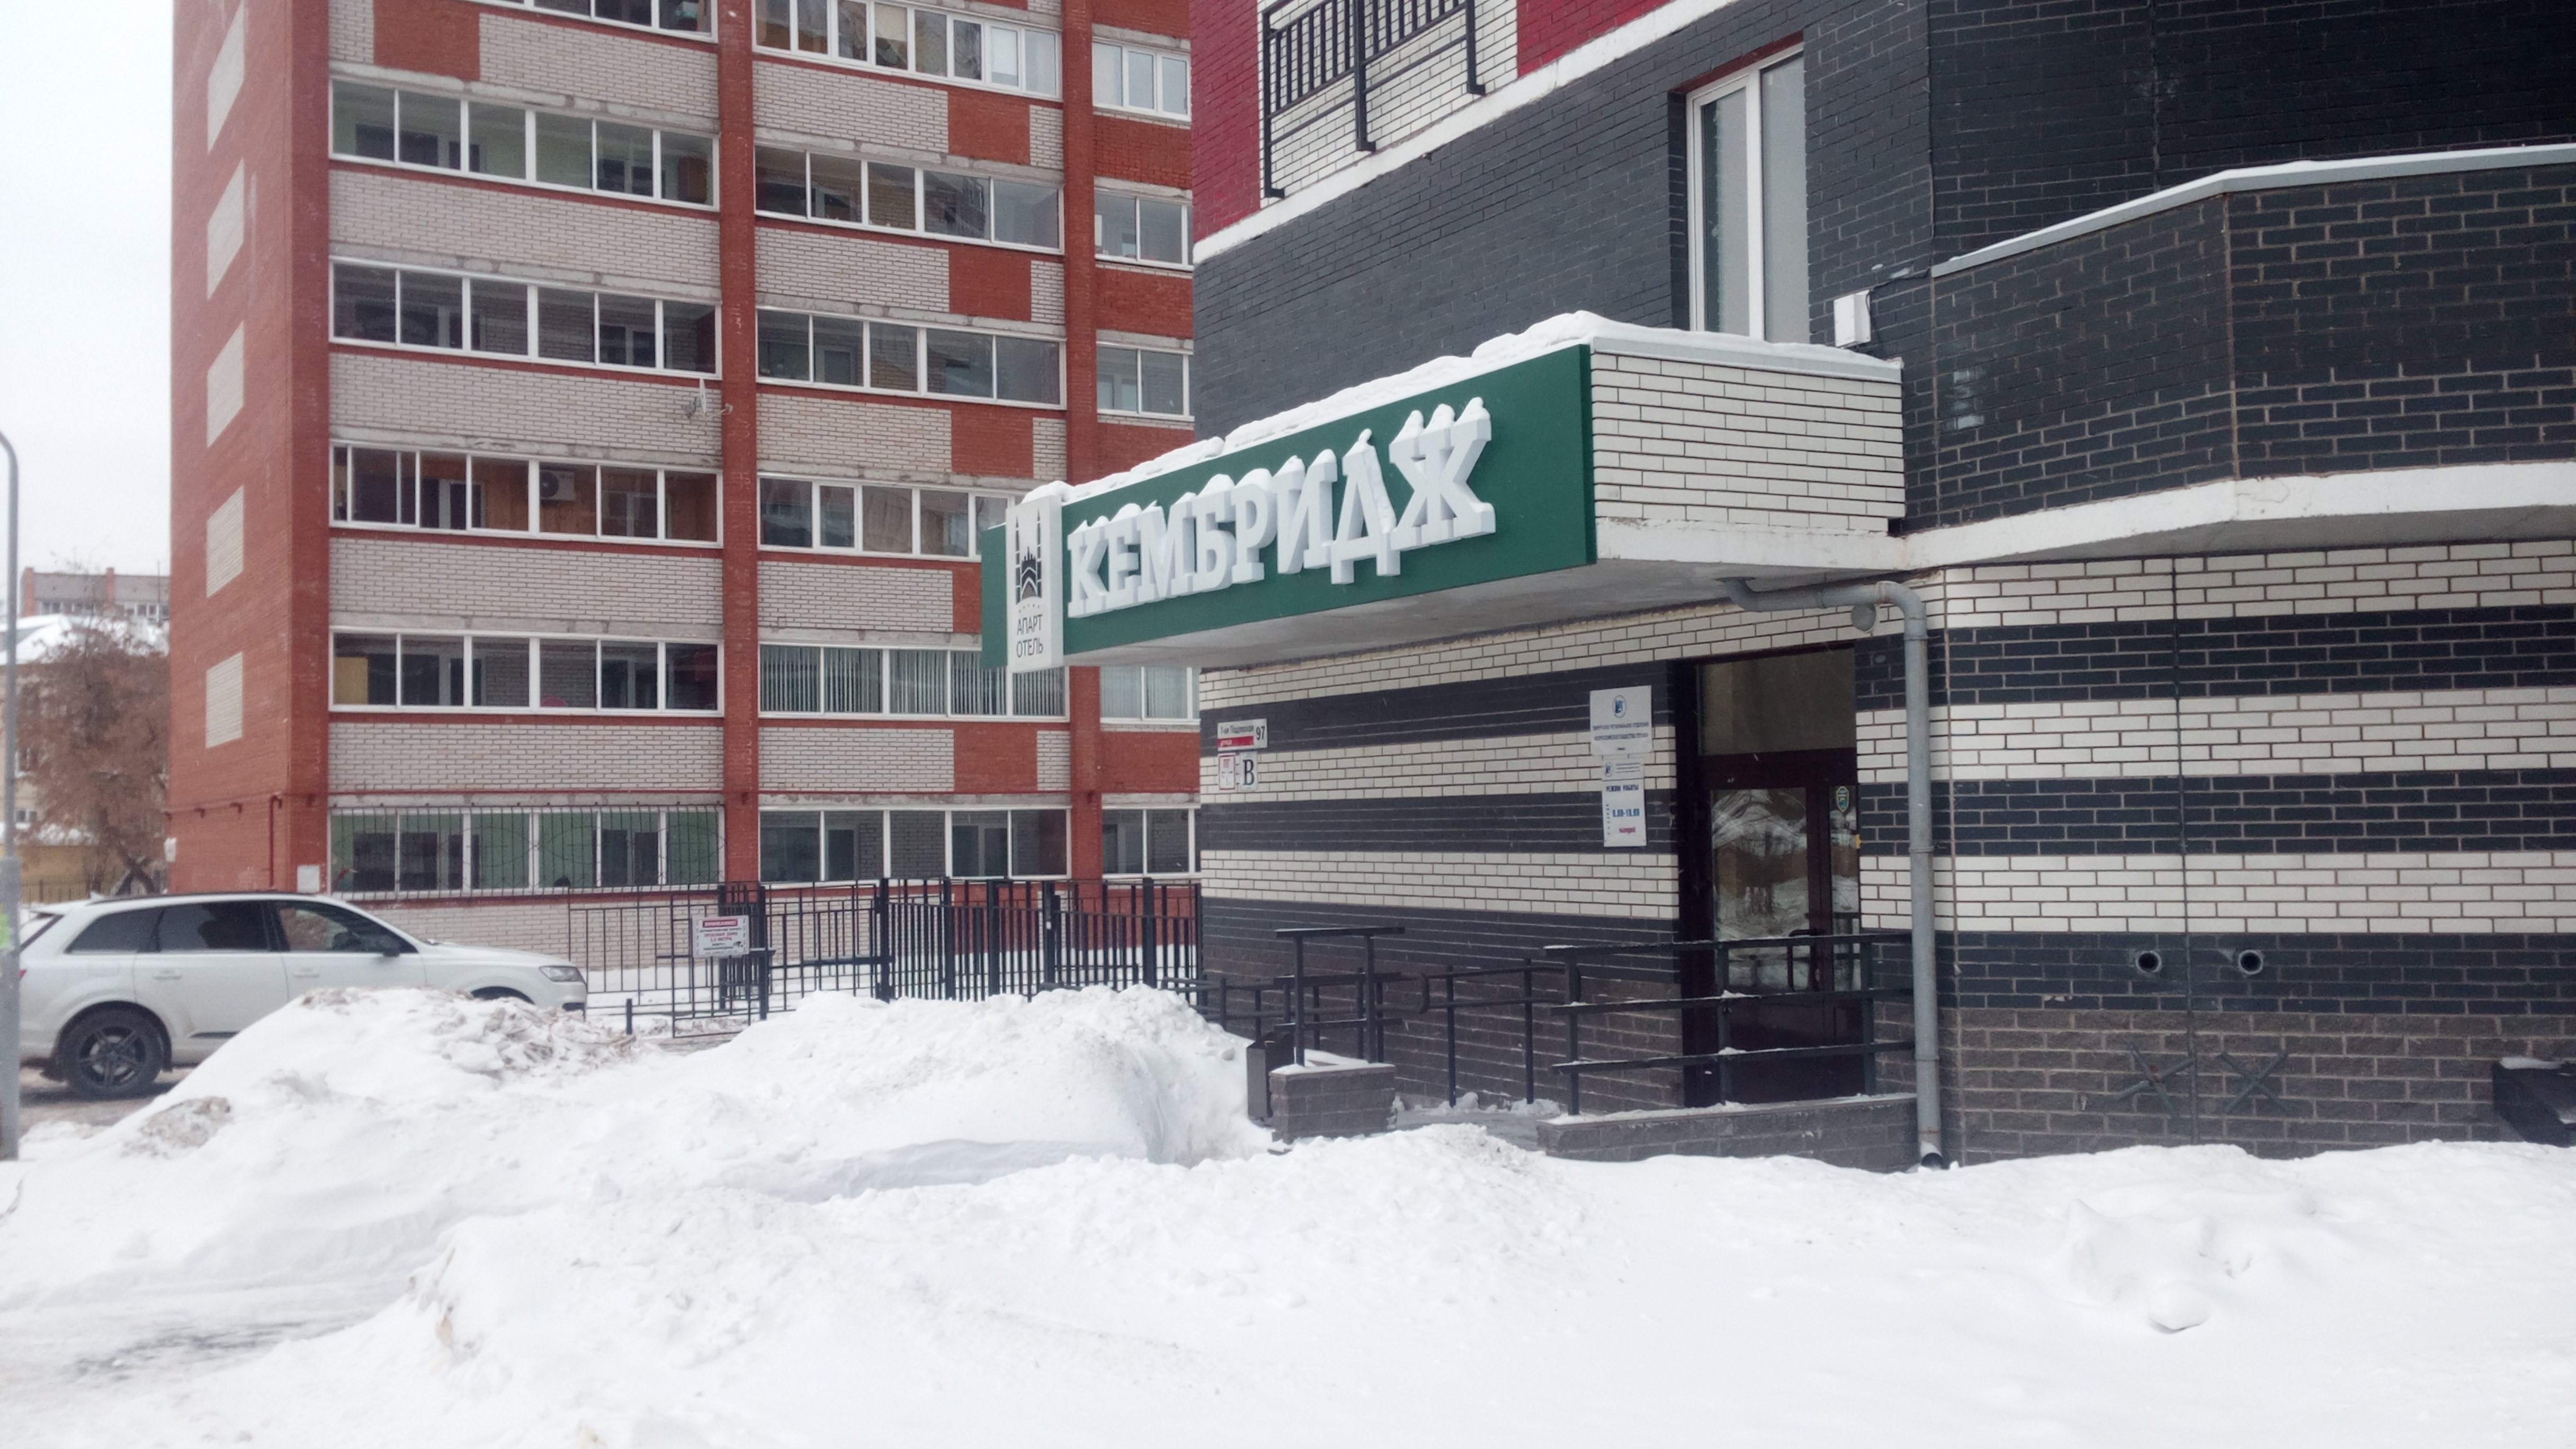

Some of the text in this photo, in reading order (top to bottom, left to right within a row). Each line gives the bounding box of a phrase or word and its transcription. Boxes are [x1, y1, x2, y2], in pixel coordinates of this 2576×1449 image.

[1066, 408, 1497, 619] КЕМБРИДЖ
[1016, 614, 1043, 636] АПАРТ
[1016, 637, 1044, 658] ОТЕЛЬ
[1256, 725, 1266, 740] 97
